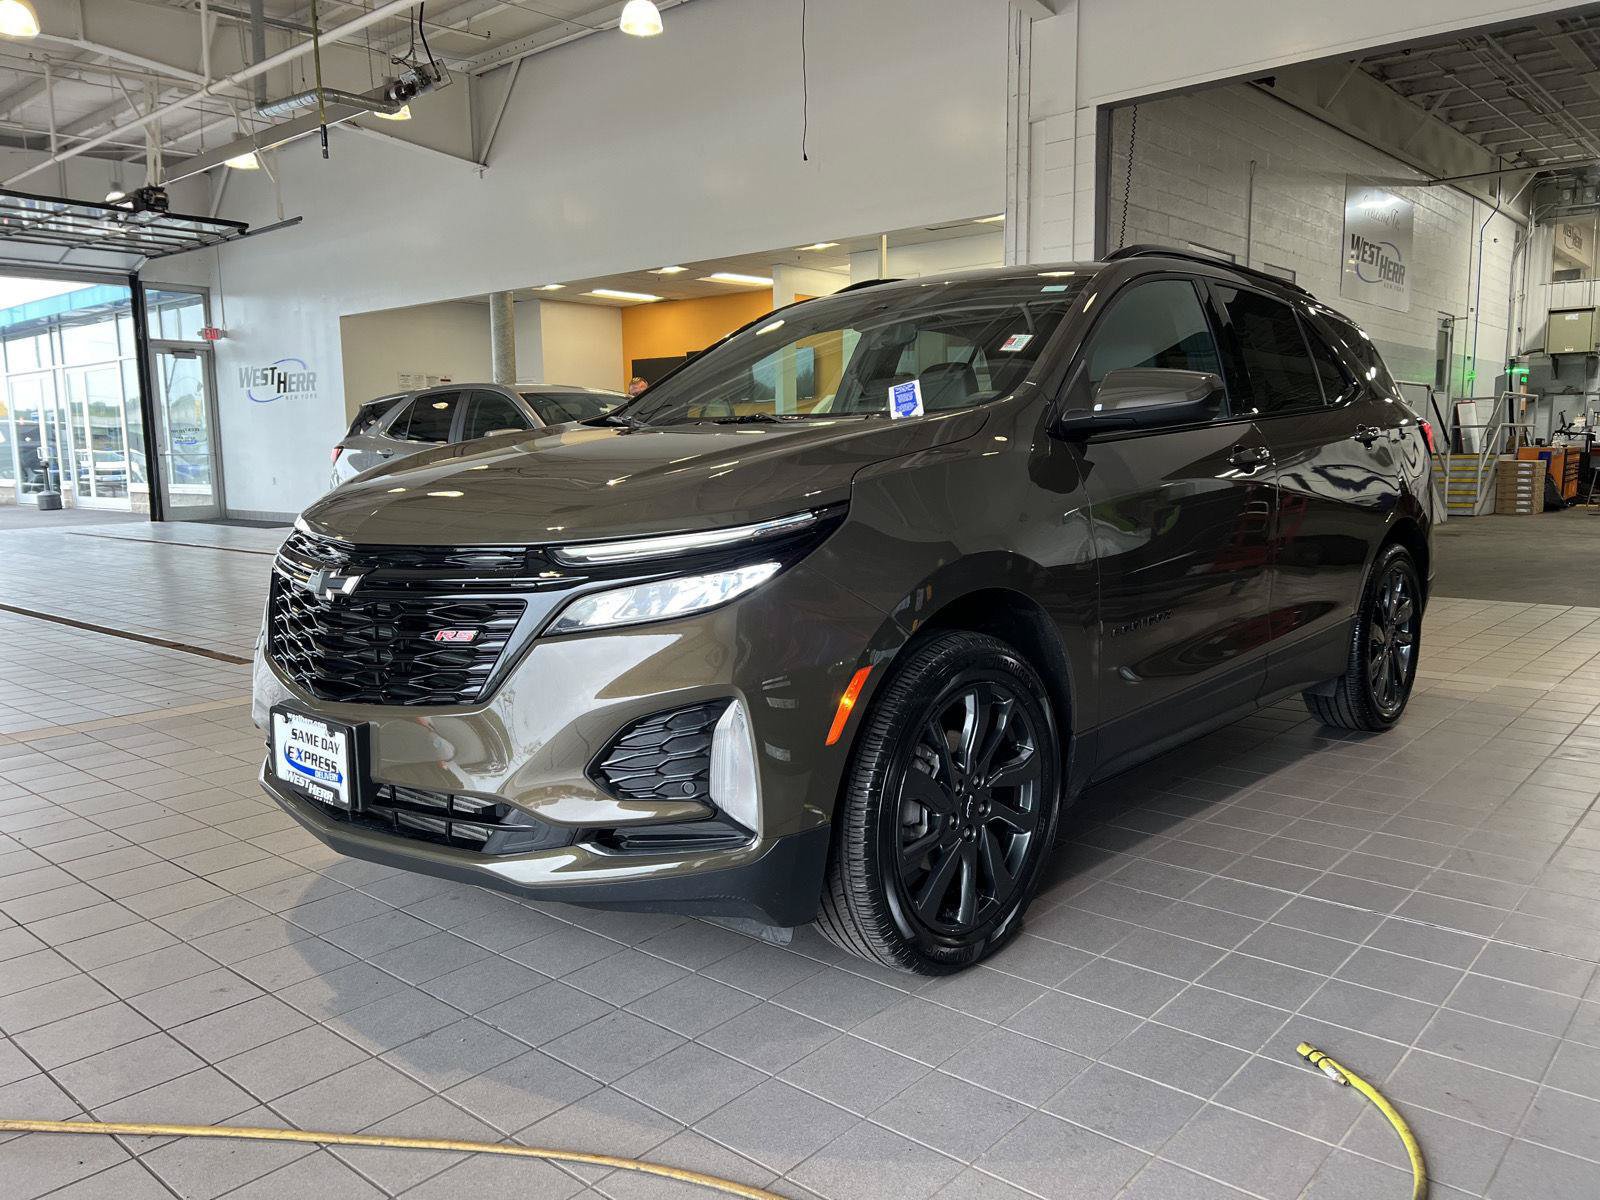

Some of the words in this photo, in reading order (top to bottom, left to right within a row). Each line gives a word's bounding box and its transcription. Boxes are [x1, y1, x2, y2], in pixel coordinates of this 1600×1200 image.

[1350, 234, 1382, 267] WEST
[1378, 255, 1406, 286] HERR
[239, 366, 278, 389] WEST
[276, 371, 317, 394] HERR
[434, 630, 477, 641] RS
[291, 728, 319, 748] SAME
[321, 737, 341, 755] DAY
[287, 745, 338, 773] EXPRESS
[287, 771, 311, 789] WEST
[308, 782, 334, 802] HERR
